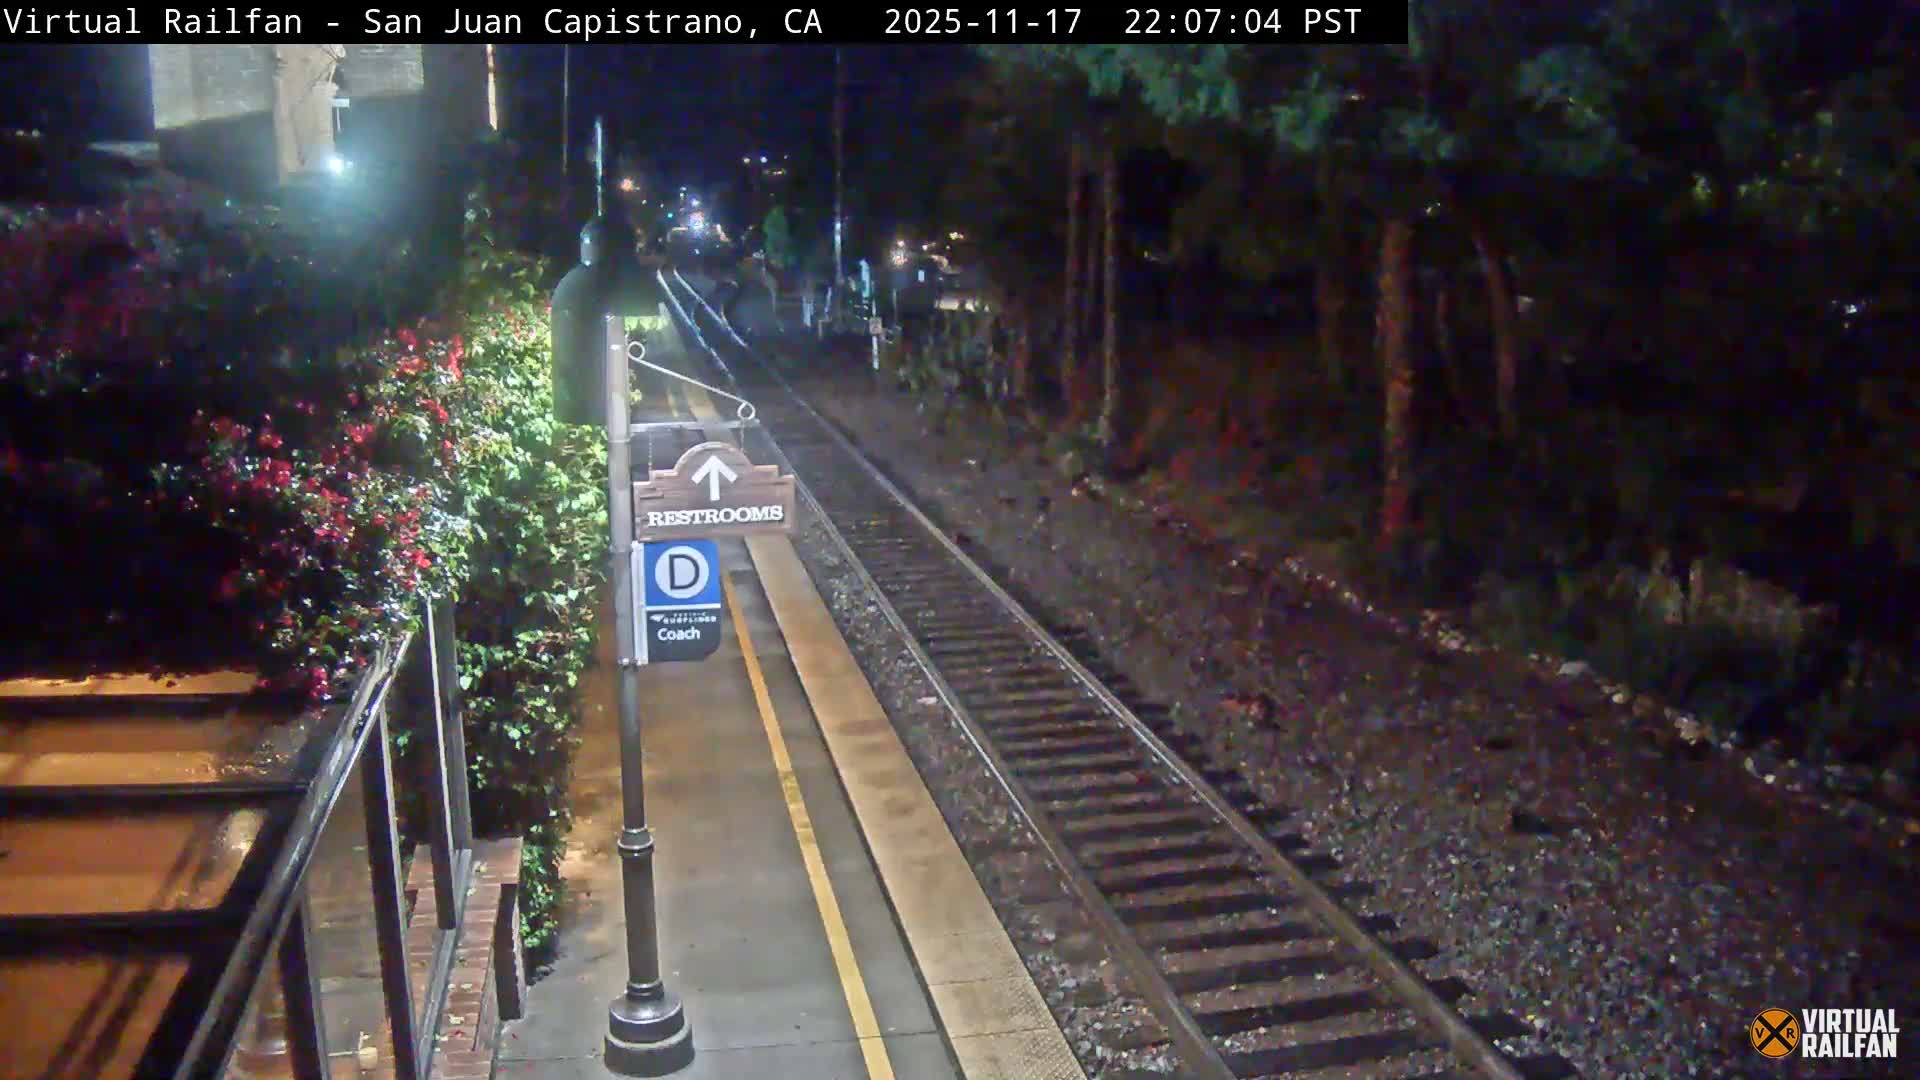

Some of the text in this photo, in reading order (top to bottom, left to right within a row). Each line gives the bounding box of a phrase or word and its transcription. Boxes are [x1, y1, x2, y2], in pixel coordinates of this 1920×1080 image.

[647, 505, 784, 527] RESTROOMS
[668, 553, 700, 591] D
[657, 625, 701, 642] Coach
